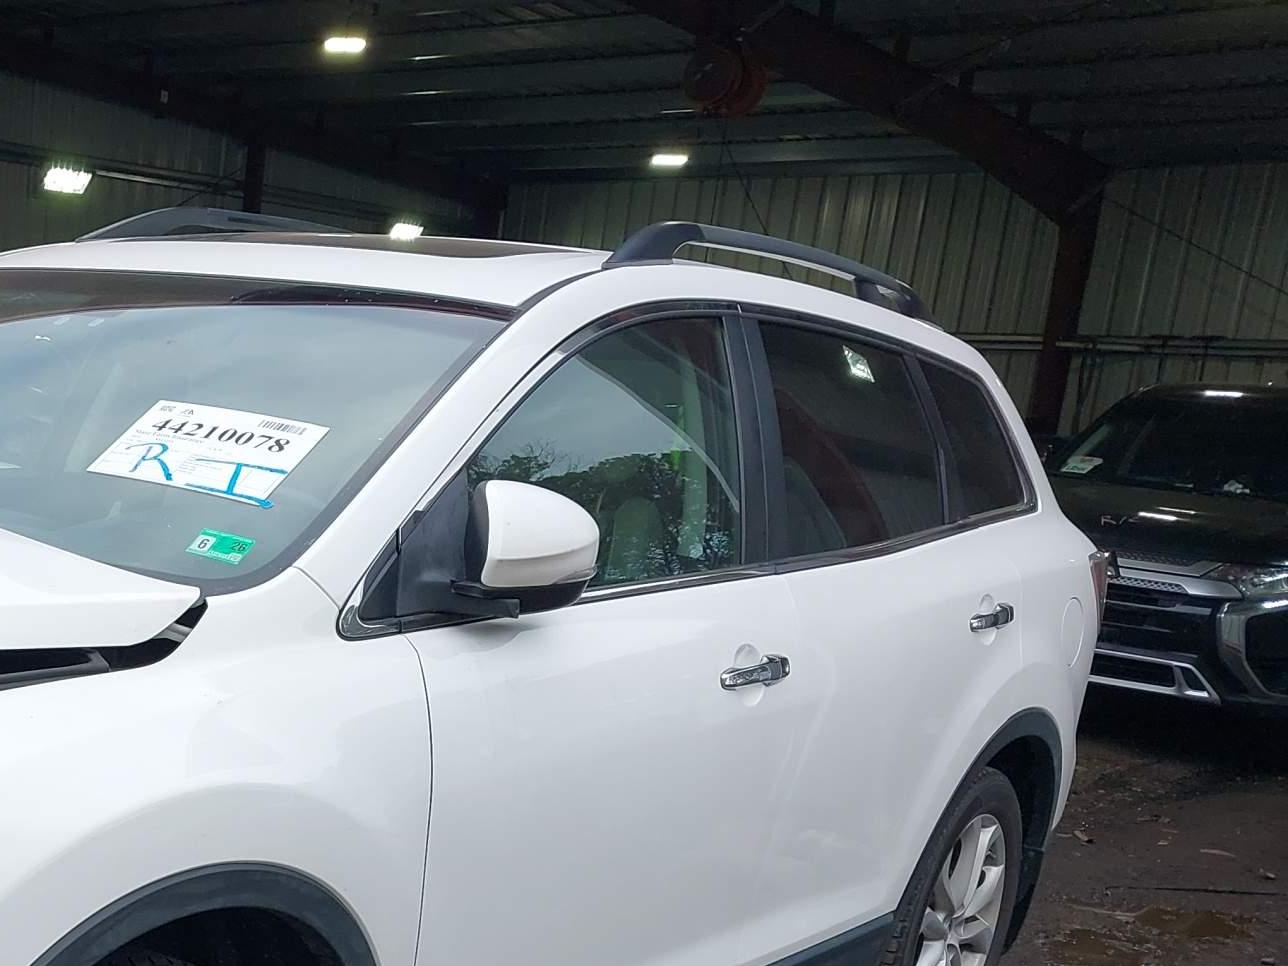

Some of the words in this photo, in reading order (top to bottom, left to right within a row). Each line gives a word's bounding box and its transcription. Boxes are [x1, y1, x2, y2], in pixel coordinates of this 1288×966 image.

[152, 418, 290, 453] 44210078
[125, 442, 173, 481] R
[197, 538, 211, 550] 6
[231, 541, 248, 553] 26
